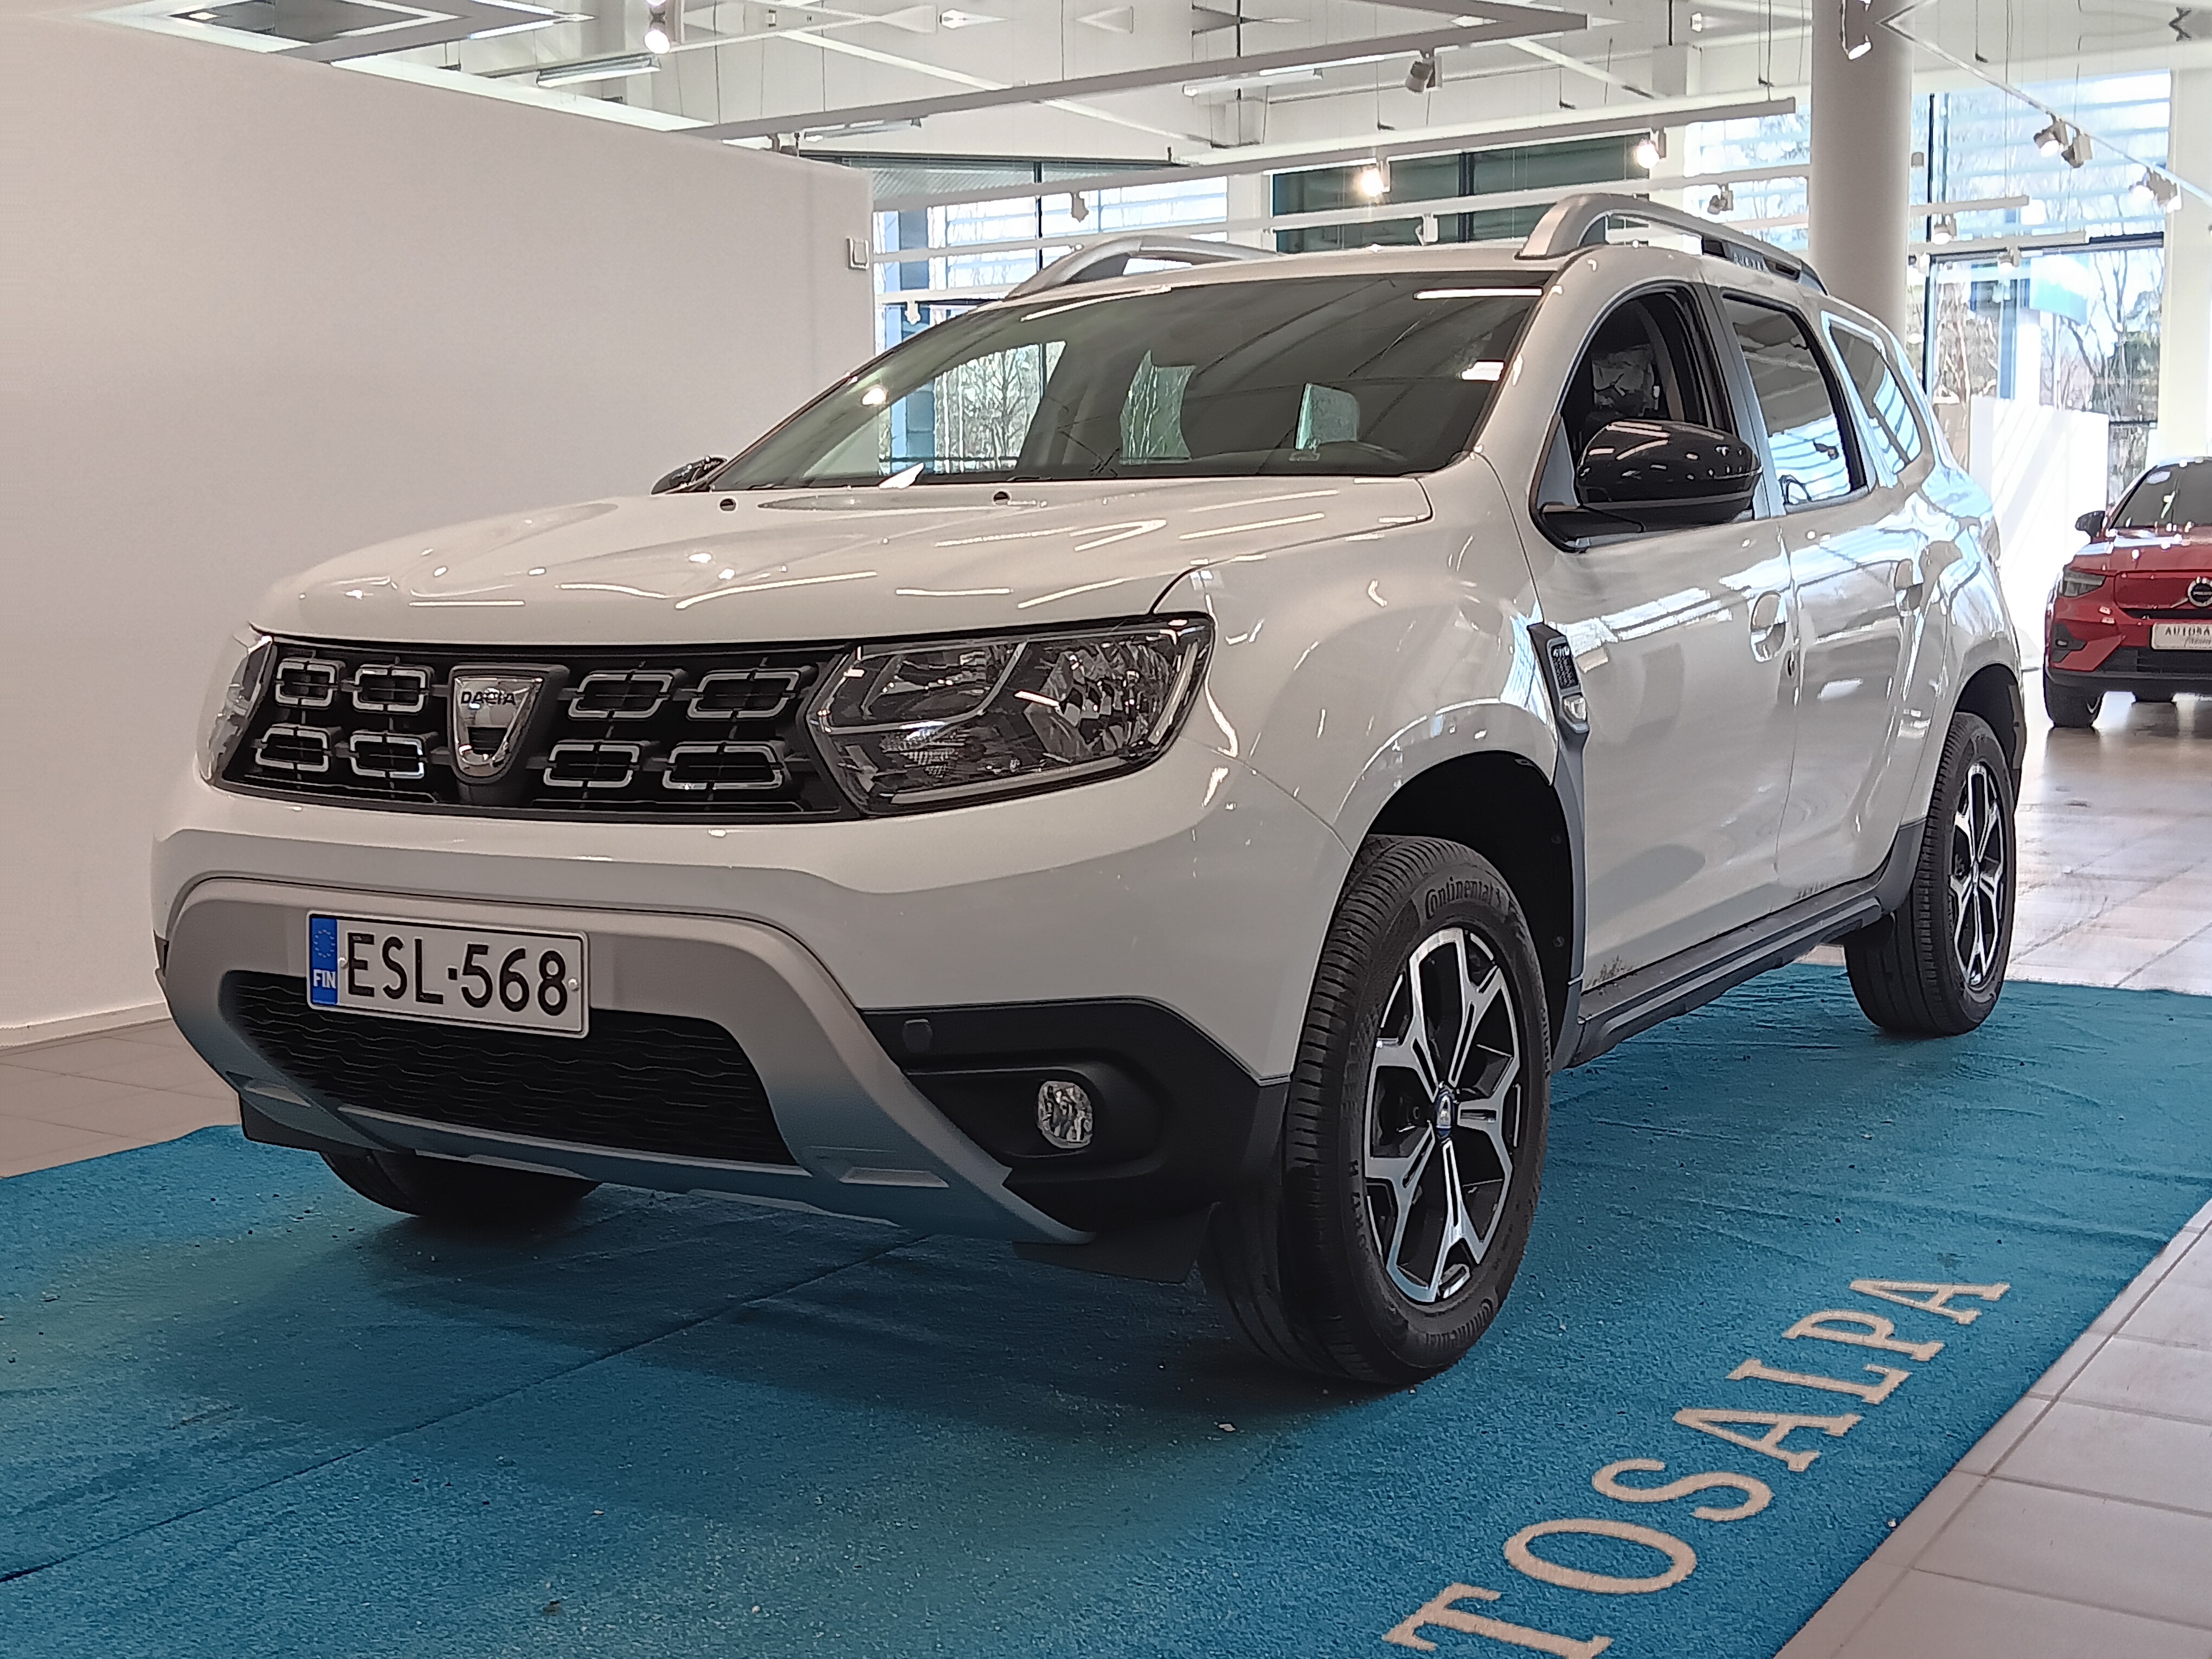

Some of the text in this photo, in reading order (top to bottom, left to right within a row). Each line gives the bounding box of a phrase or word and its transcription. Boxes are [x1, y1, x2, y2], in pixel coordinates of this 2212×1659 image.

[461, 691, 516, 705] DACIA
[313, 969, 336, 989] FIN
[348, 932, 568, 1016] ESL-568
[1382, 1278, 2010, 1659] TOSALPA
